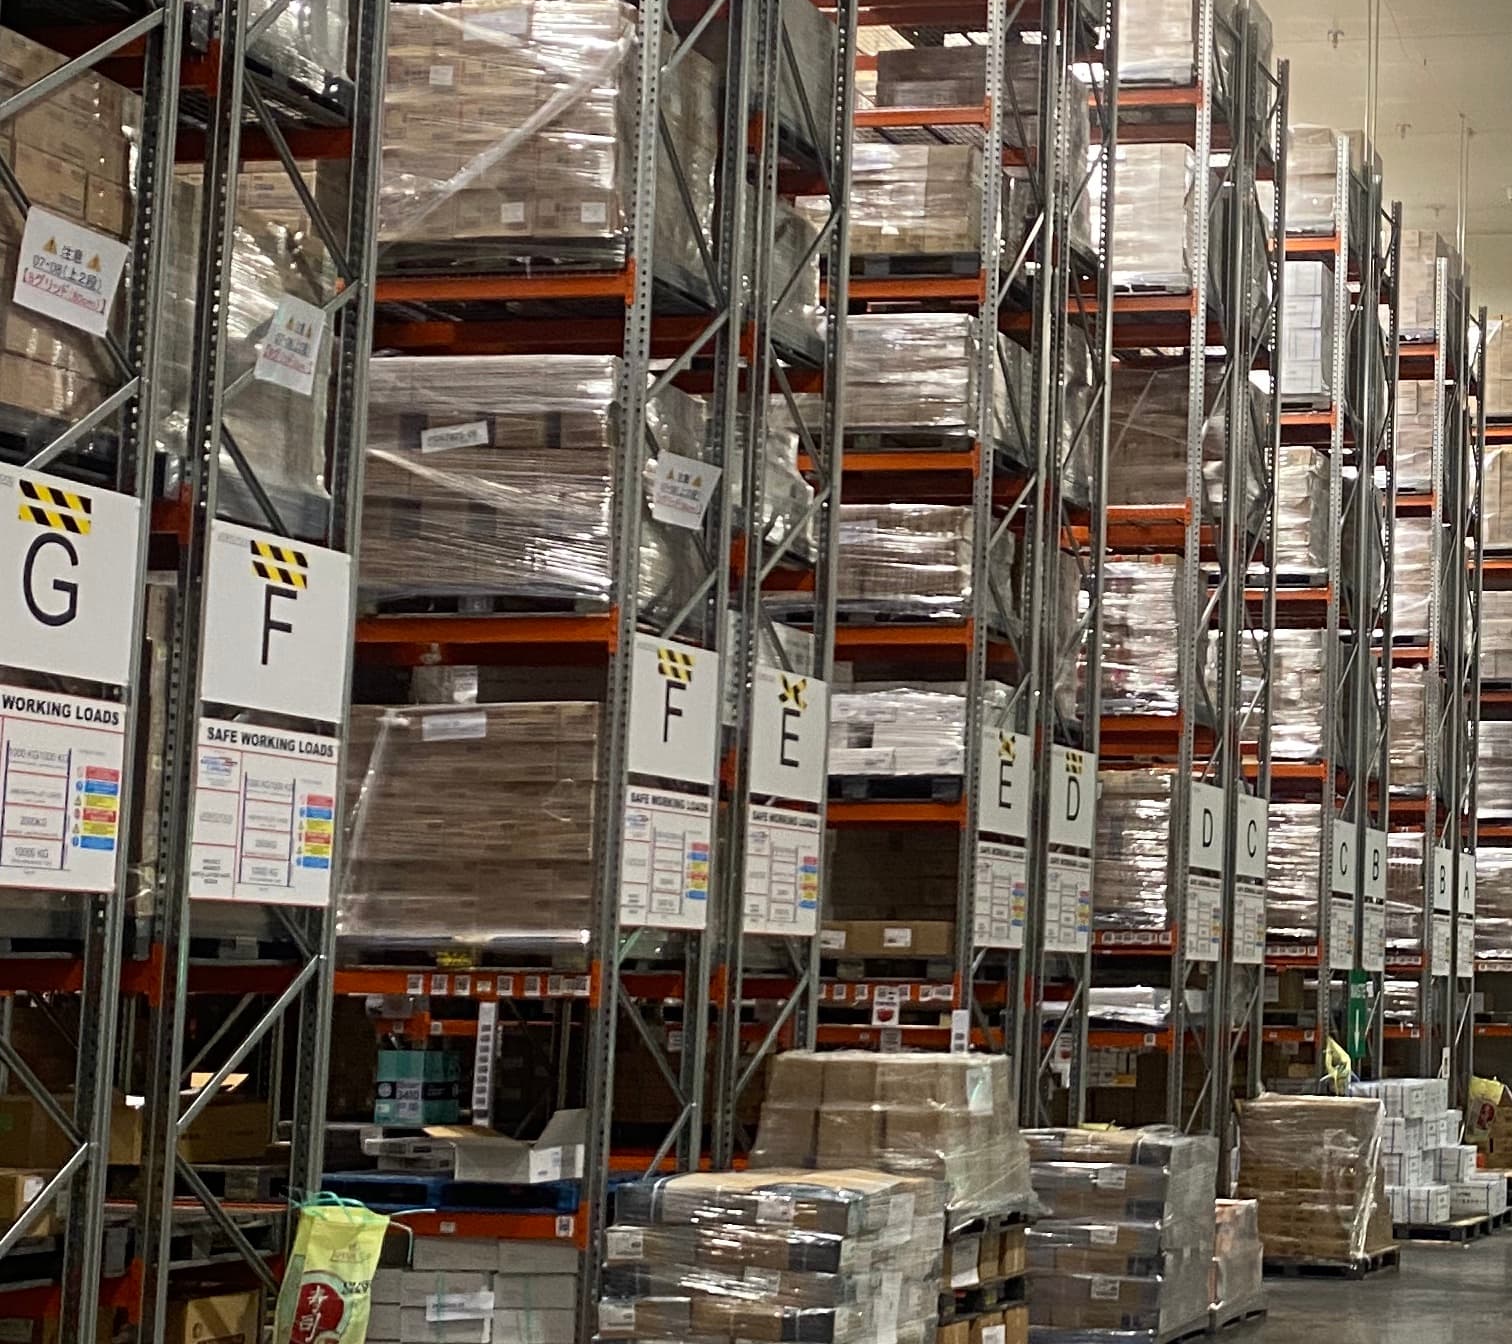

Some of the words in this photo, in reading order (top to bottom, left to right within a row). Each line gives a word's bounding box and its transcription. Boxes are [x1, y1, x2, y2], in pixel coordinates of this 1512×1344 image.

[23, 532, 79, 627] G
[261, 583, 298, 666] F
[2, 693, 72, 719] WORKING
[75, 706, 120, 726] LOADS
[663, 679, 687, 743] F
[207, 726, 237, 744] SAFE
[241, 731, 296, 753] WORKING
[298, 740, 335, 758] LOADS
[780, 707, 801, 768] E
[999, 759, 1014, 809] E
[1066, 775, 1081, 822] D
[1202, 807, 1214, 848] D
[1247, 819, 1258, 859] C
[1339, 842, 1349, 876] C
[1372, 849, 1380, 881] B
[1439, 864, 1446, 895] B
[1463, 870, 1470, 901] A
